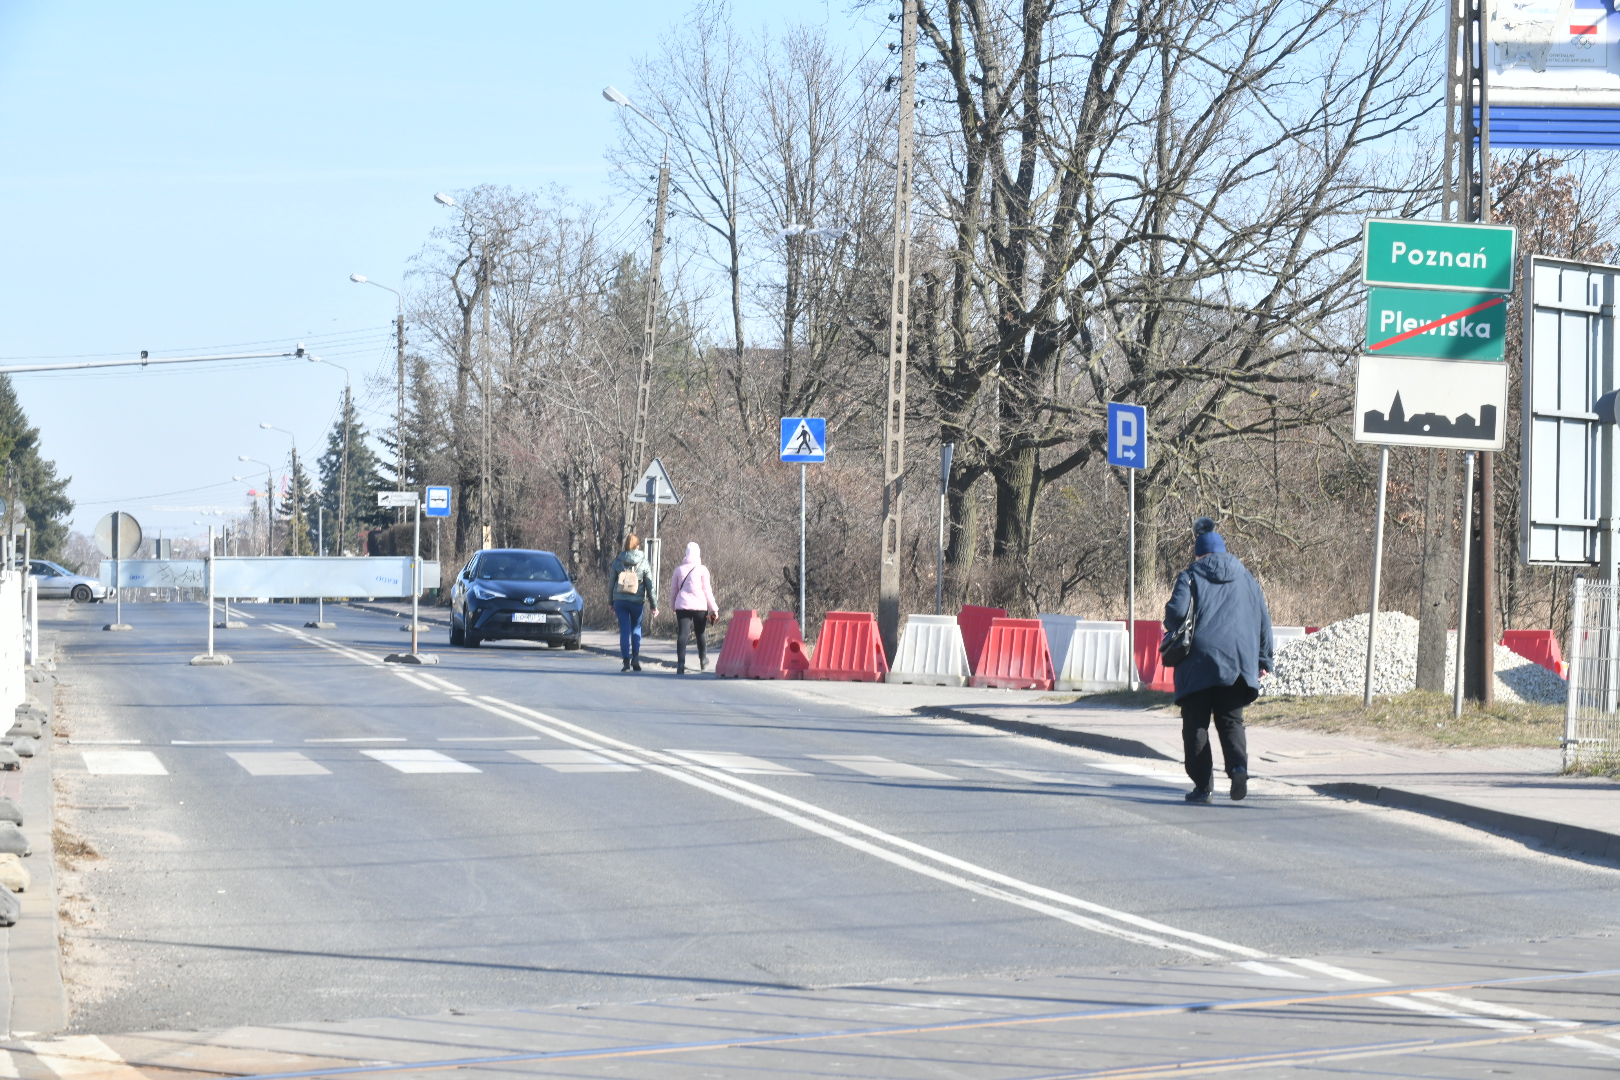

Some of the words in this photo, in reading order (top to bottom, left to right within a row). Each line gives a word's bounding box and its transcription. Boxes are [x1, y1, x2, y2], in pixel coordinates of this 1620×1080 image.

[1391, 241, 1487, 269] Poznań
[1380, 310, 1491, 339] Plewiska
[1117, 410, 1138, 459] P
